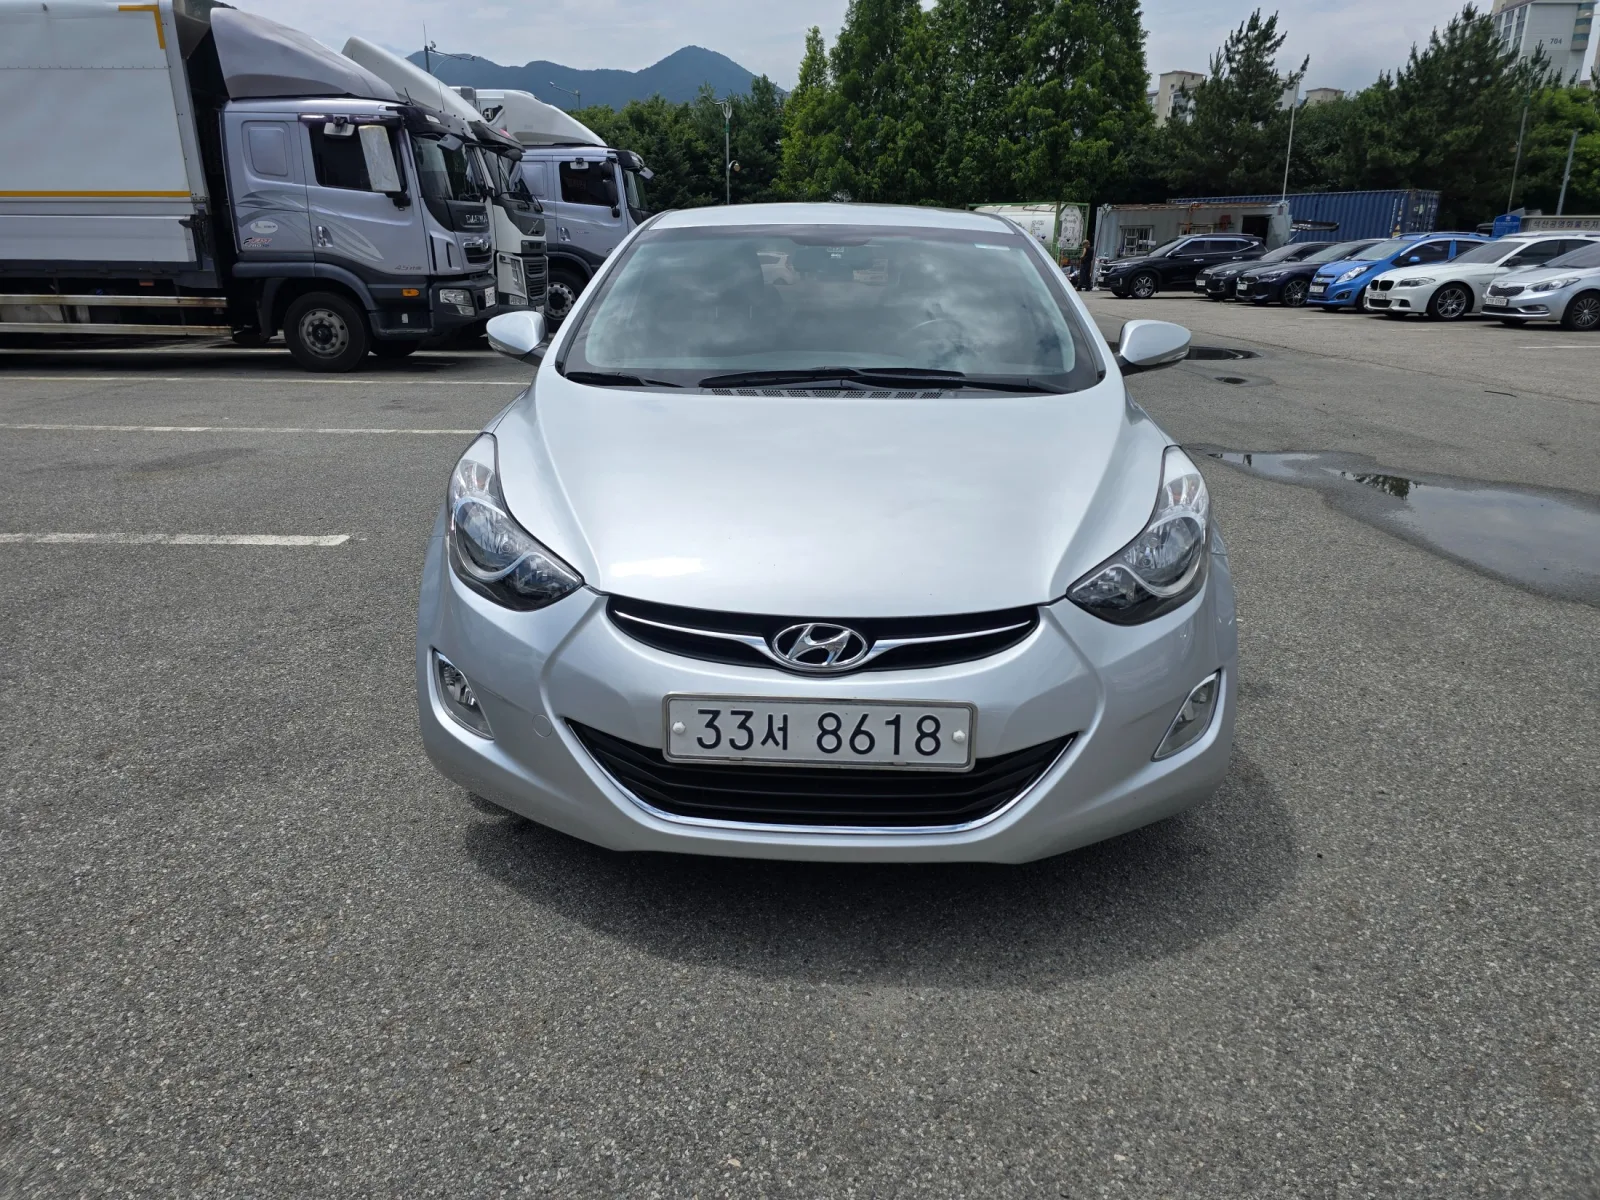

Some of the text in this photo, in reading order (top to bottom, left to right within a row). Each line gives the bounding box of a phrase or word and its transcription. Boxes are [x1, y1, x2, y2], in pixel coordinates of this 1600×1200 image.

[1550, 37, 1562, 45] 704
[696, 708, 942, 756] 33서 8618
